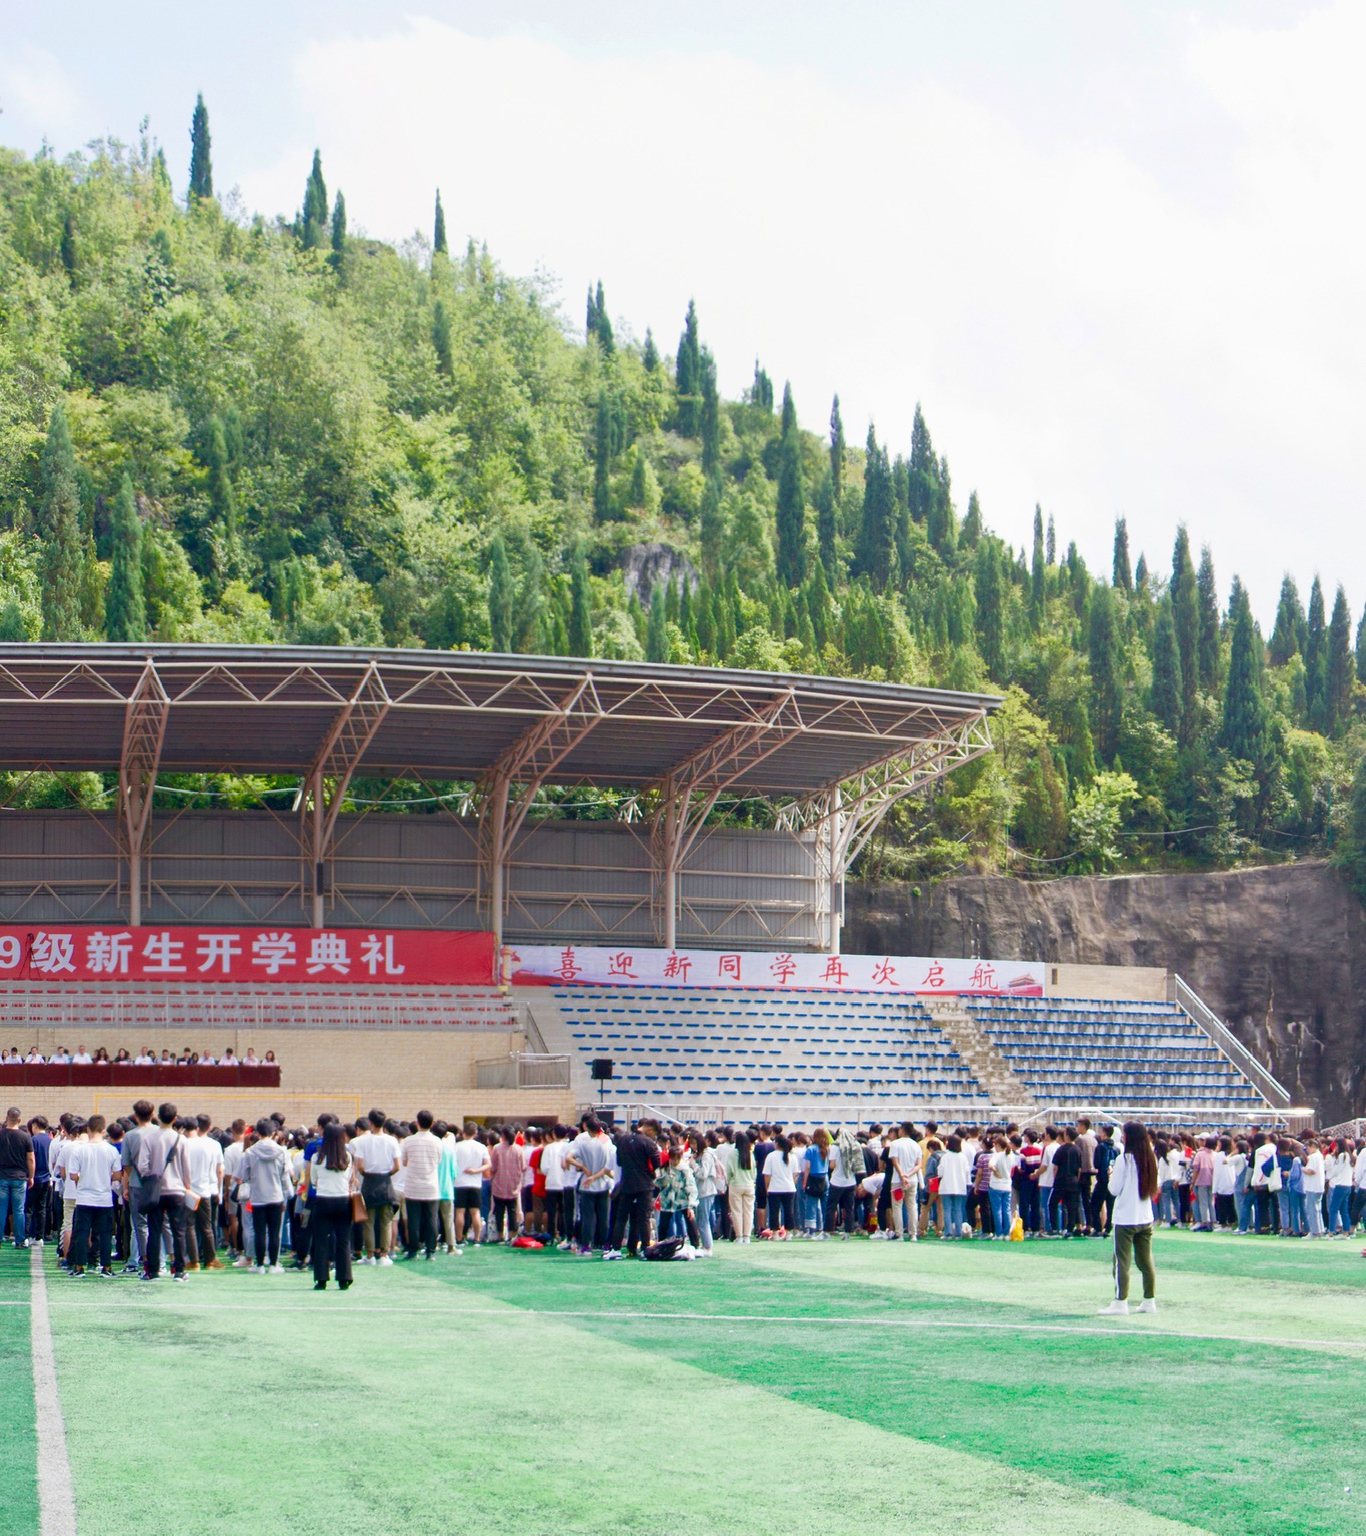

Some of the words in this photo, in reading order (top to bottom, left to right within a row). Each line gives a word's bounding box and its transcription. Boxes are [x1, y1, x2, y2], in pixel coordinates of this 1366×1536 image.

[553, 945, 999, 990] 喜迎新同学再次启航
